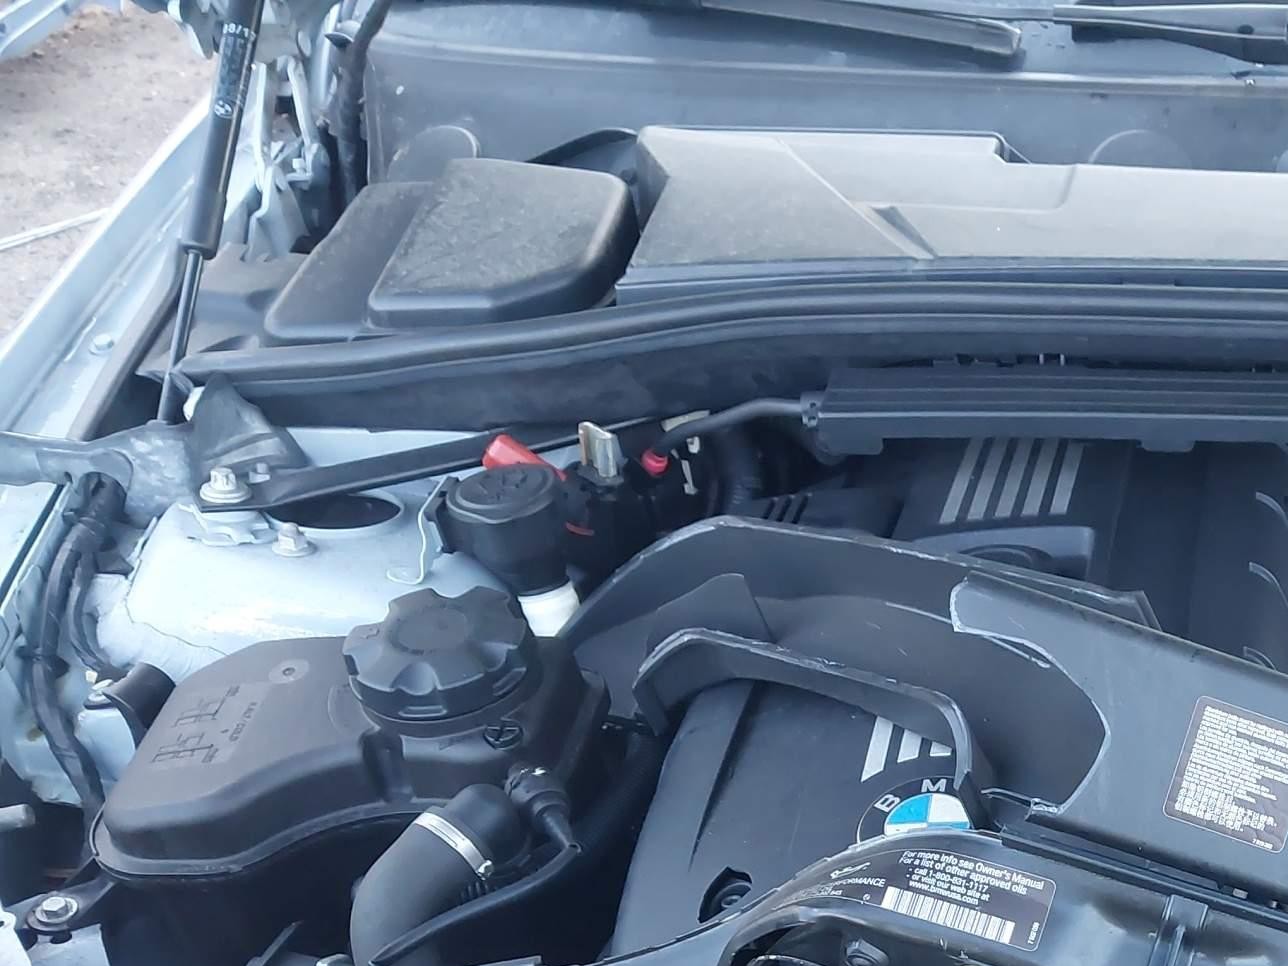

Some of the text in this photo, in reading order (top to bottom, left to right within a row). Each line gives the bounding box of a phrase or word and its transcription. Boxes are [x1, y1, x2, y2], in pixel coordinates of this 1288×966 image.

[900, 856, 912, 865] For
[921, 858, 934, 870] list
[935, 860, 946, 872] of
[945, 864, 968, 880] other
[970, 869, 1010, 892] approved
[1011, 881, 1028, 896] oils
[904, 851, 1044, 890] For more info see Owner's Manual
[914, 867, 988, 892] call 1-800-831-1117
